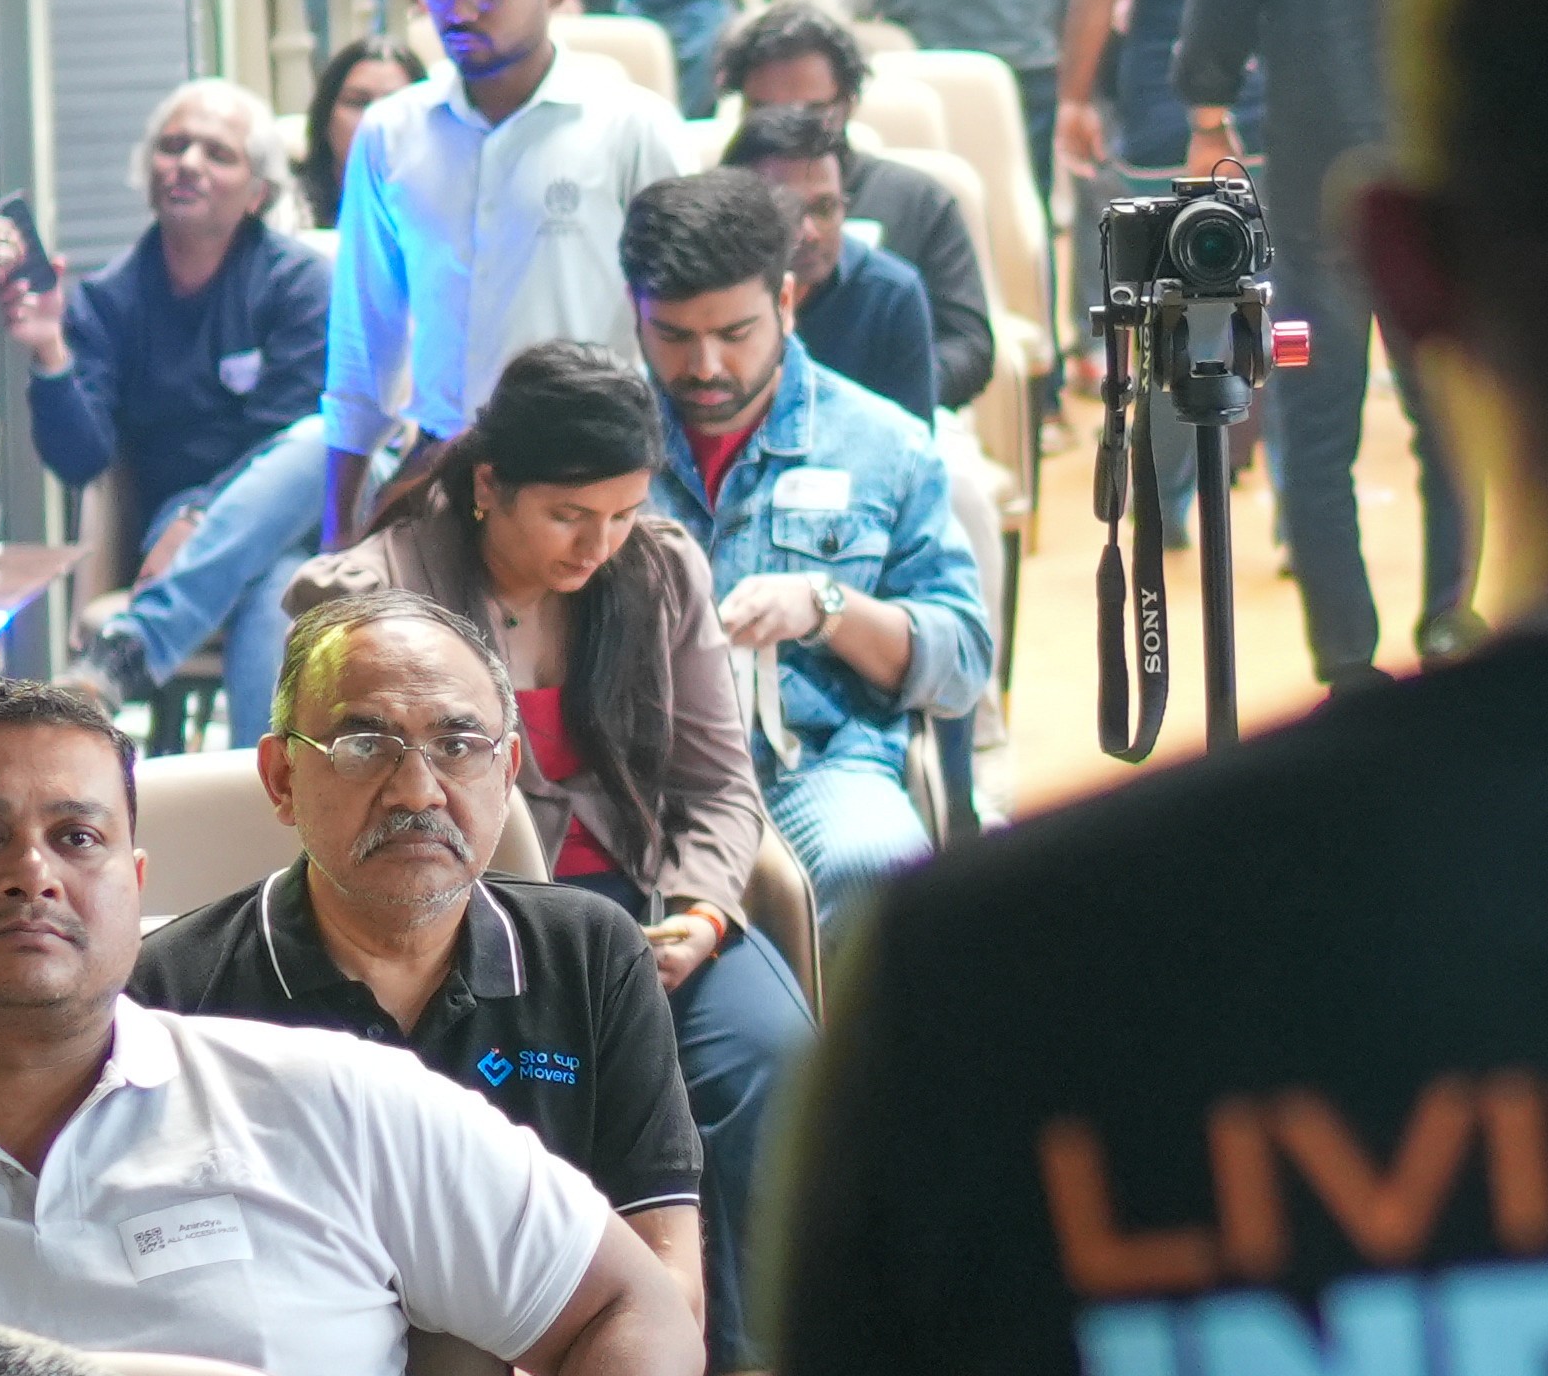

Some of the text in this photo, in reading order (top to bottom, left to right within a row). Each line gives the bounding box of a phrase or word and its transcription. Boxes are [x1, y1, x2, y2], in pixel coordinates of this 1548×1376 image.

[1141, 587, 1161, 674] SONY
[519, 1050, 580, 1071] Statup
[520, 1066, 576, 1084] Movers
[167, 1236, 183, 1244] ALL
[185, 1228, 216, 1240] ACCESS
